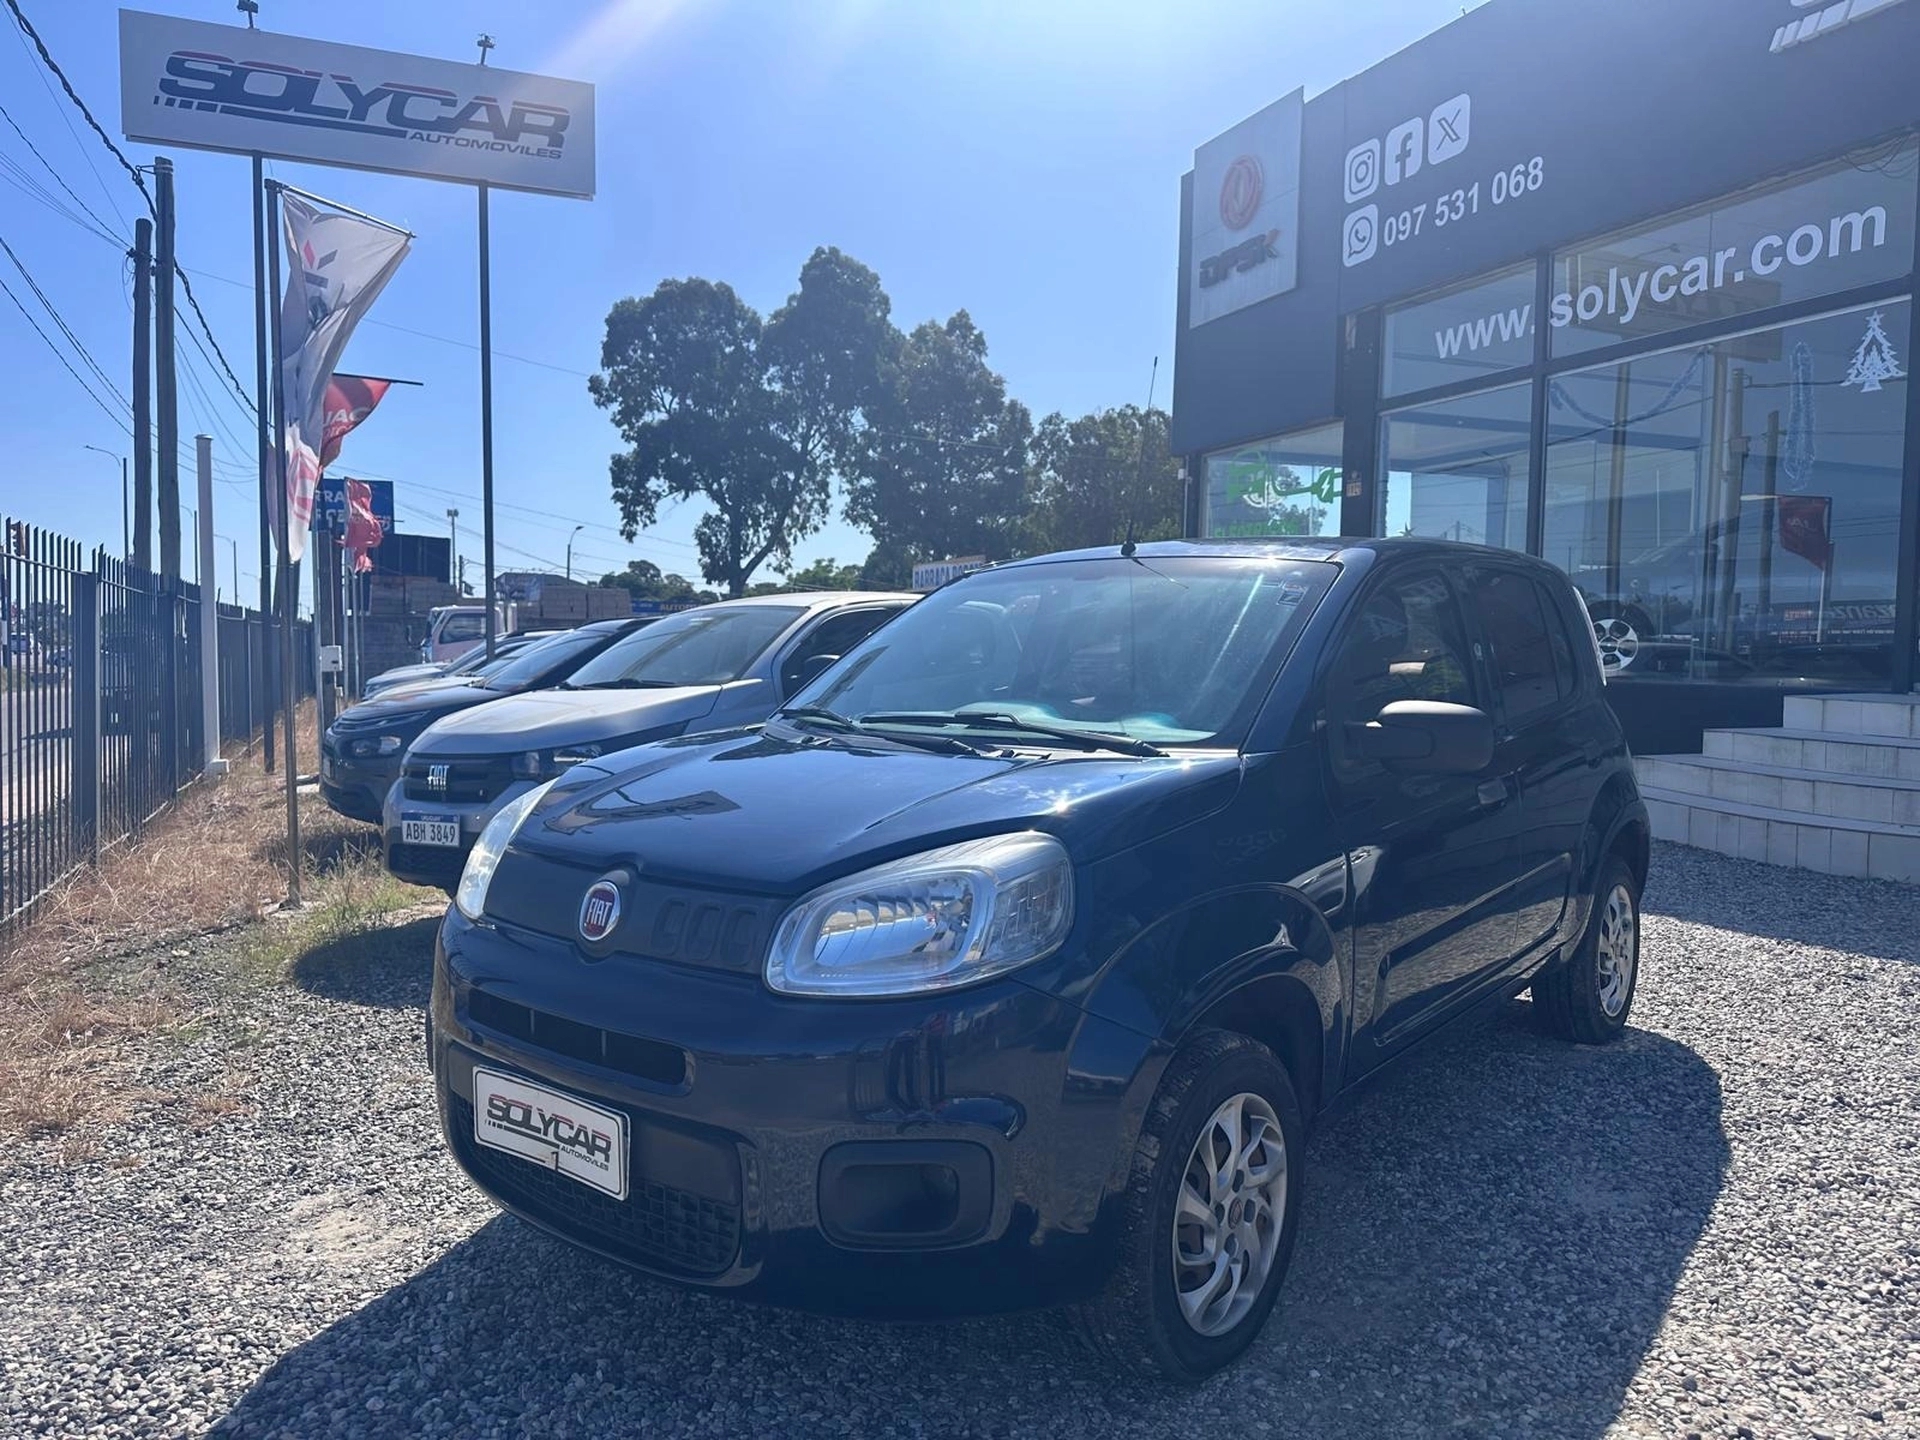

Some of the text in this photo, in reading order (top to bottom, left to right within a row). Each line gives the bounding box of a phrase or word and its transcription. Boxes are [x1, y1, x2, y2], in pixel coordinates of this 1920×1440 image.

[159, 50, 571, 148] SOLYCAR
[409, 130, 563, 160] AUTOMOVILES
[1383, 156, 1544, 246] 097 531 068
[1549, 204, 1887, 328] solycar.com
[406, 822, 456, 844] ABH 3849
[586, 897, 613, 927] FIAT
[486, 1093, 612, 1163] SOLYCAR
[561, 1145, 609, 1172] AUTOMOVILES
